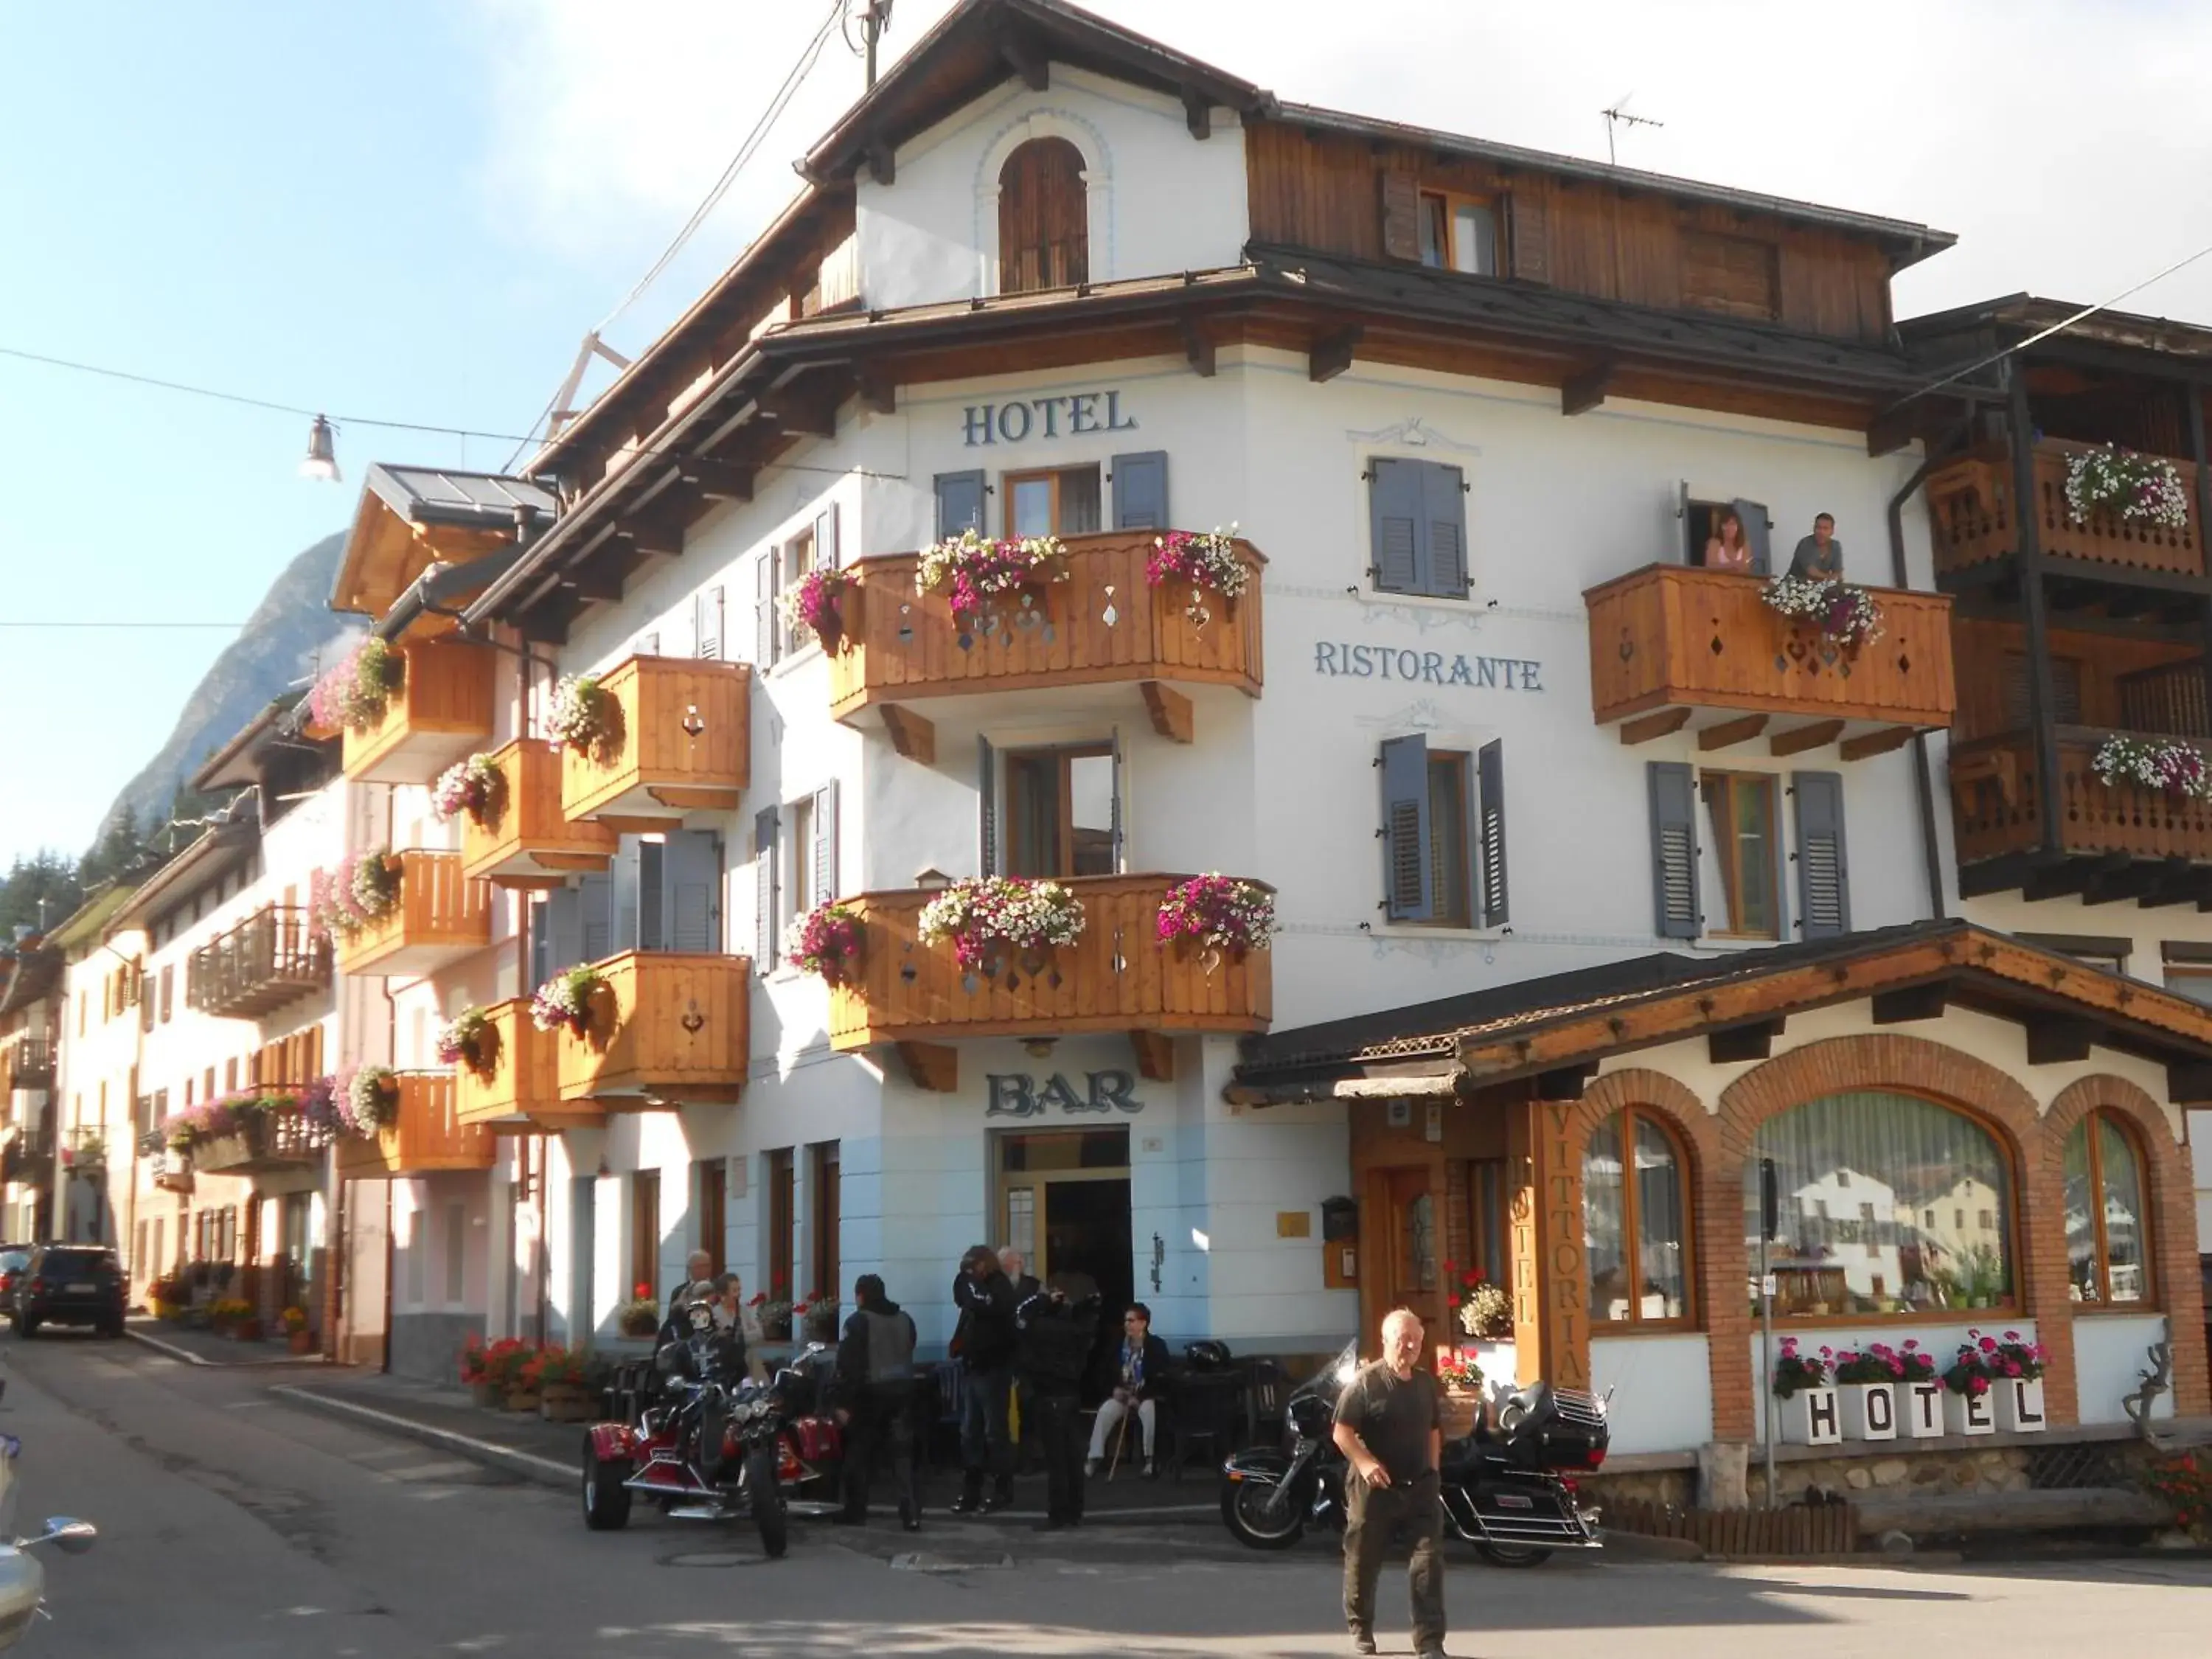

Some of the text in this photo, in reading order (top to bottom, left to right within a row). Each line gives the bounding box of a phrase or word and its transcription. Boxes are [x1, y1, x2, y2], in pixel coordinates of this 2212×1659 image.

[961, 390, 1139, 447] HOTEL
[1315, 641, 1544, 692] RISTORANTE
[986, 1070, 1145, 1118] BAR
[1547, 1106, 1582, 1381] VITTORIA
[1809, 1382, 2042, 1438] HOTEL
